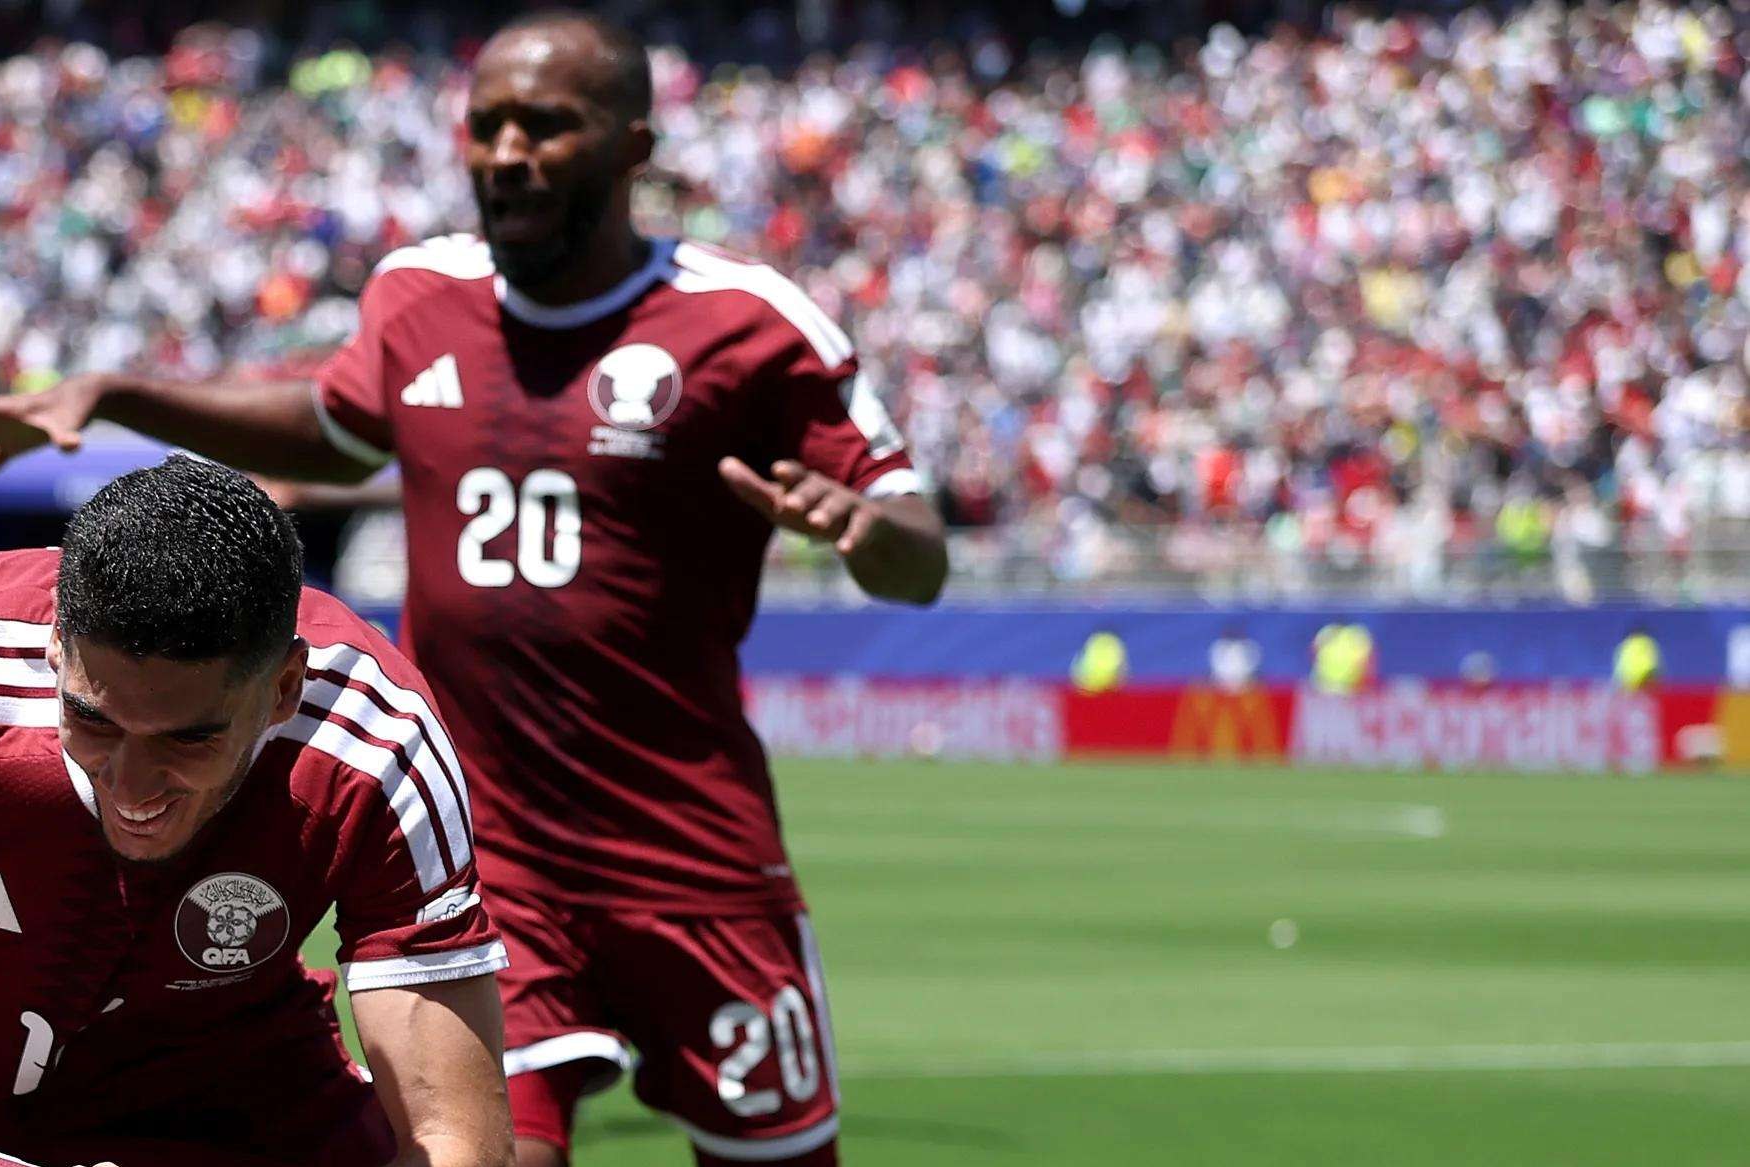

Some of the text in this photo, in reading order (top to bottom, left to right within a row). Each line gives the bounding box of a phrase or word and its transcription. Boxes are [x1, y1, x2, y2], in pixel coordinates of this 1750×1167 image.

[456, 466, 582, 588] 20
[202, 946, 251, 966] QFA
[708, 984, 819, 1118] 20
